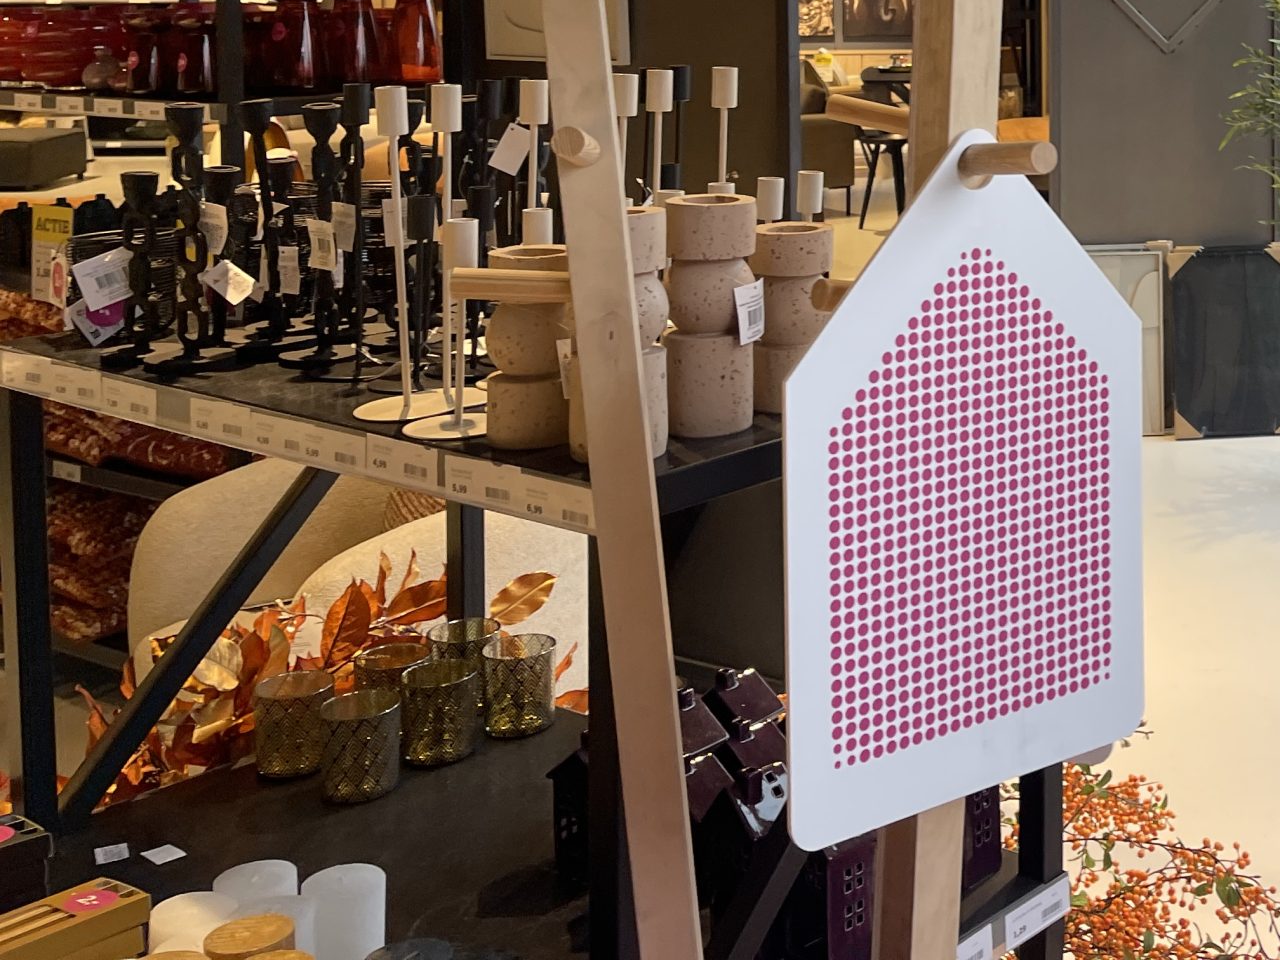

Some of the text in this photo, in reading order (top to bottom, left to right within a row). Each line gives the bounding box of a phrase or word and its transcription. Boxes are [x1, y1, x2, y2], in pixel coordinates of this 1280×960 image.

[36, 217, 70, 234] ACTIE
[372, 458, 387, 468] 4,99
[452, 484, 467, 494] 5,99
[526, 504, 542, 515] 6,99
